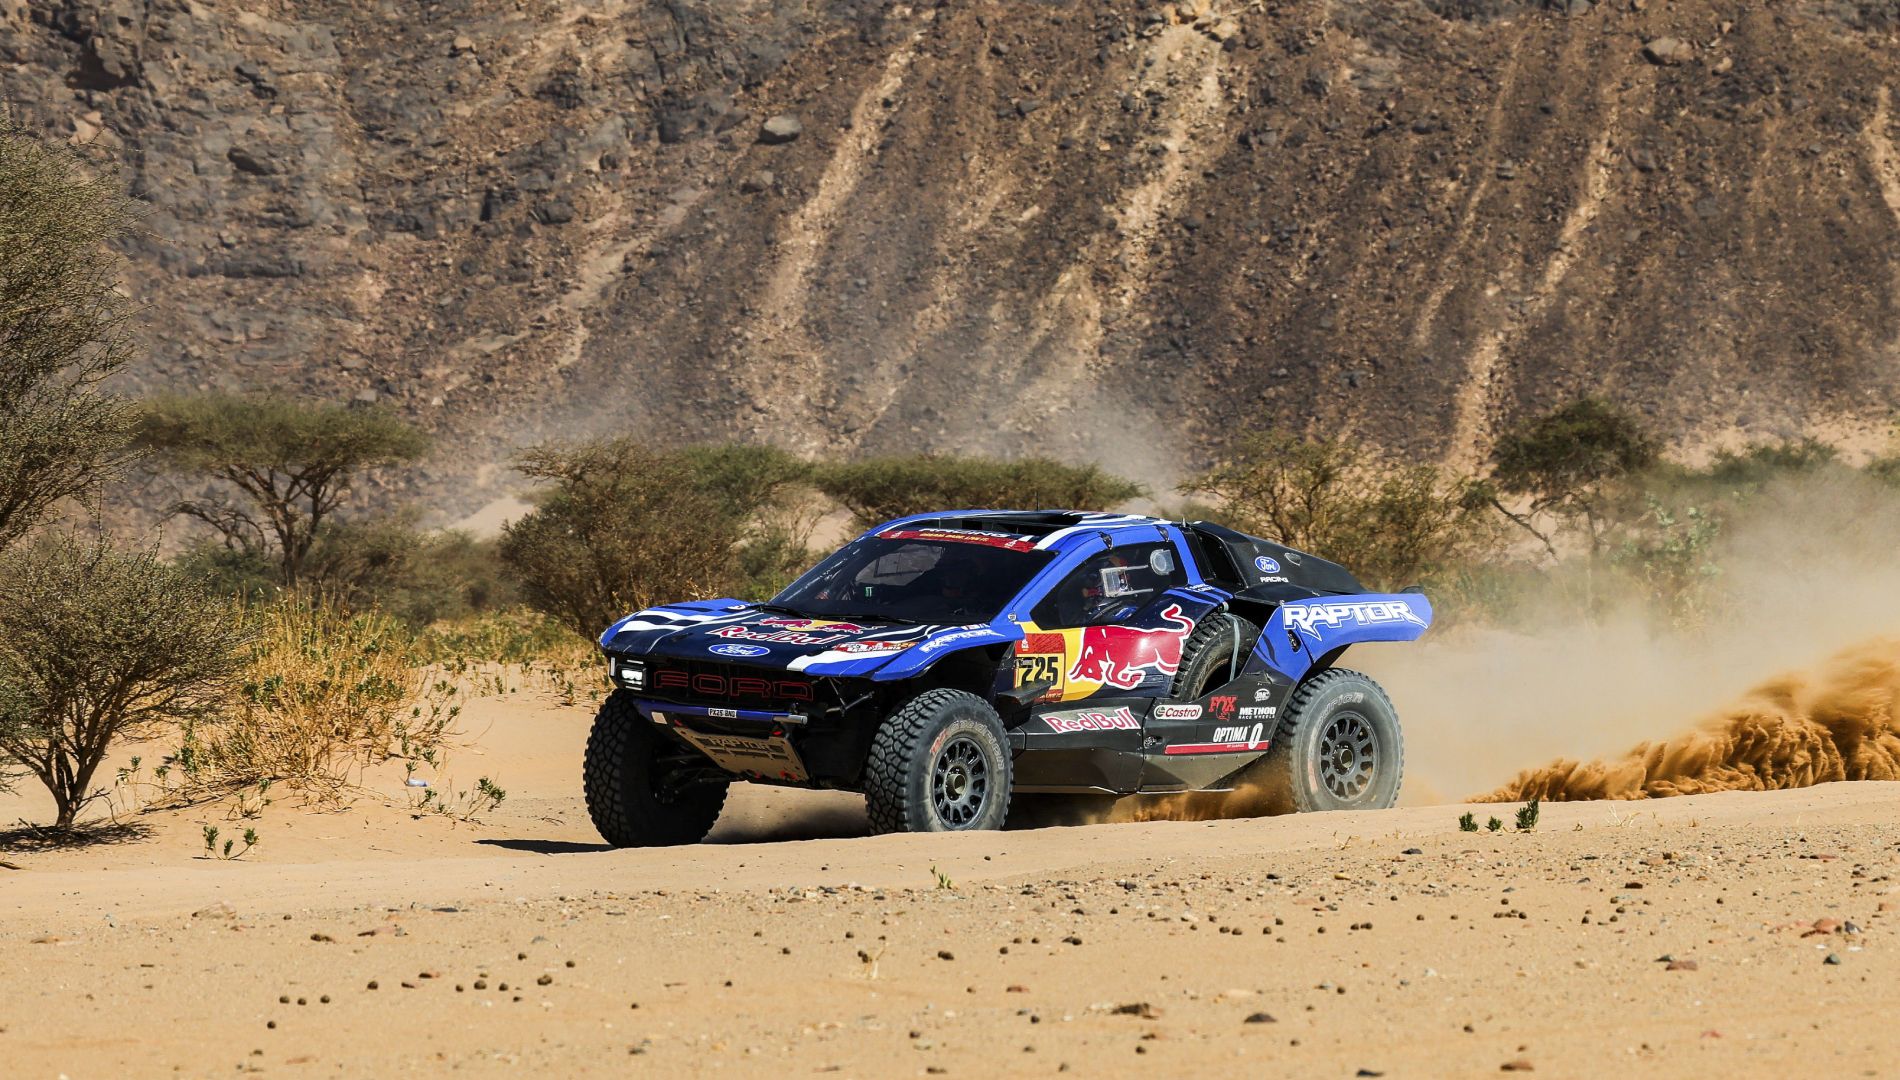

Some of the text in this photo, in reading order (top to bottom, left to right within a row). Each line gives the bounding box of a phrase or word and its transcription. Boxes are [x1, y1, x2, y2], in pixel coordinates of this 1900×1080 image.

[1259, 558, 1277, 572] Ford
[1282, 601, 1429, 642] RAPTOR
[706, 626, 850, 645] Red Bull
[919, 629, 1006, 652] RAPTOR
[653, 671, 813, 700] FORD
[1166, 707, 1200, 718] Castrol
[1208, 695, 1238, 713] FOX
[1239, 707, 1276, 715] METHOD
[1039, 706, 1141, 734] Red Bull
[710, 736, 771, 751] RAPTOR
[1212, 726, 1249, 743] OPTIMA
